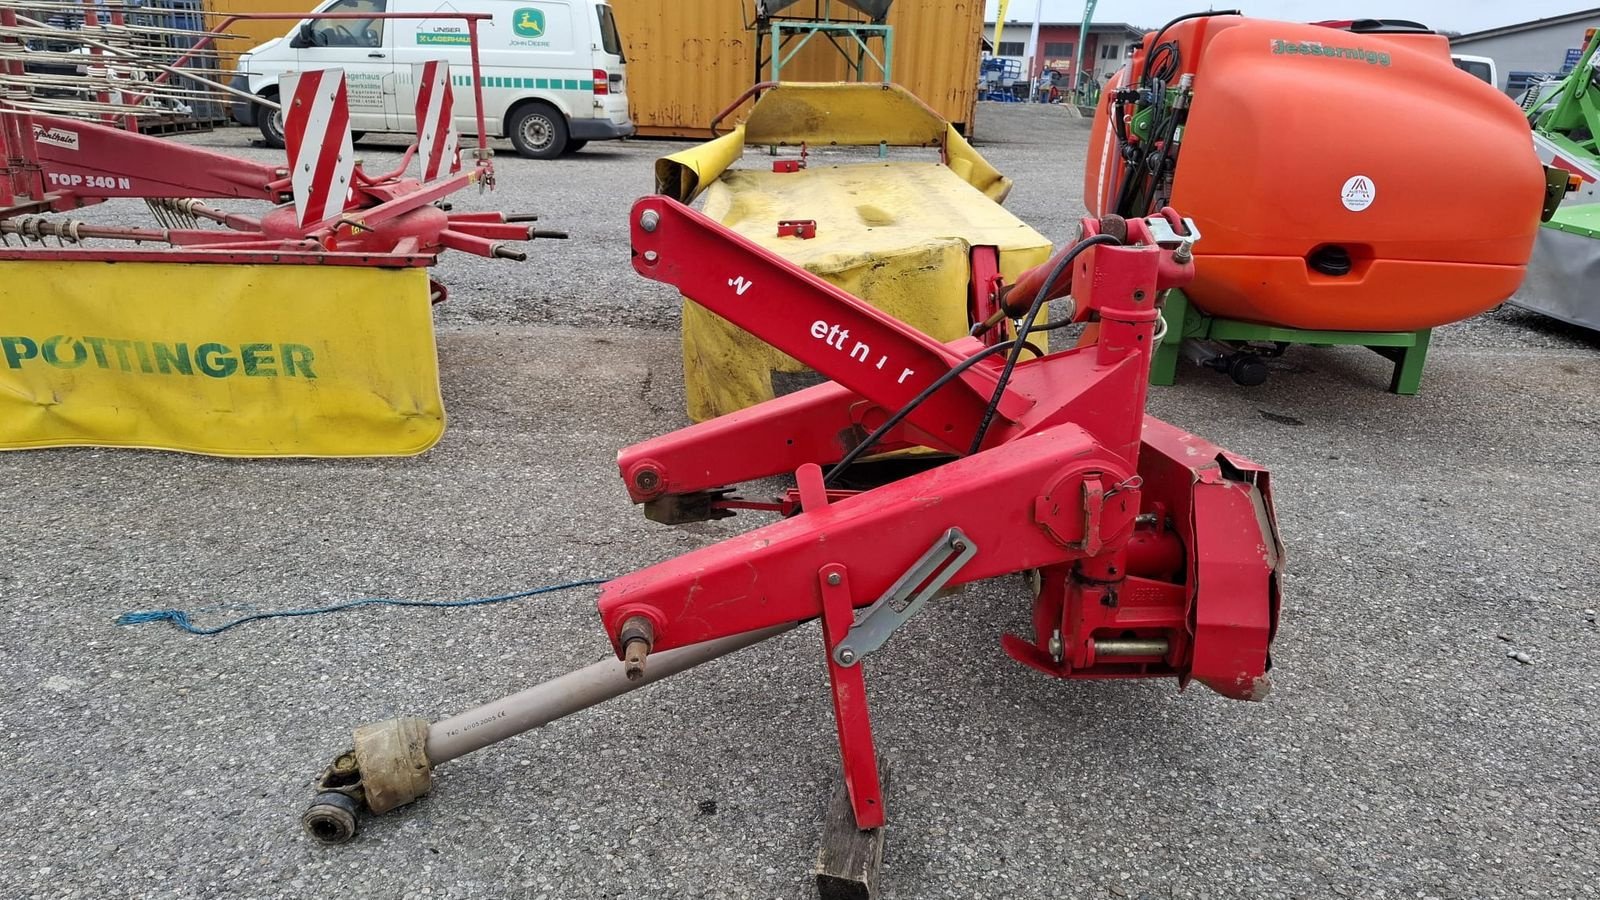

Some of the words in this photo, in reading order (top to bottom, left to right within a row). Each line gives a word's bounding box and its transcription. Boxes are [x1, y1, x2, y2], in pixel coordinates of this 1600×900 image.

[427, 35, 471, 44] LAGERHAU
[347, 72, 380, 81] agerhaus
[48, 173, 82, 186] TOP
[85, 175, 116, 189] 340
[118, 178, 130, 189] N
